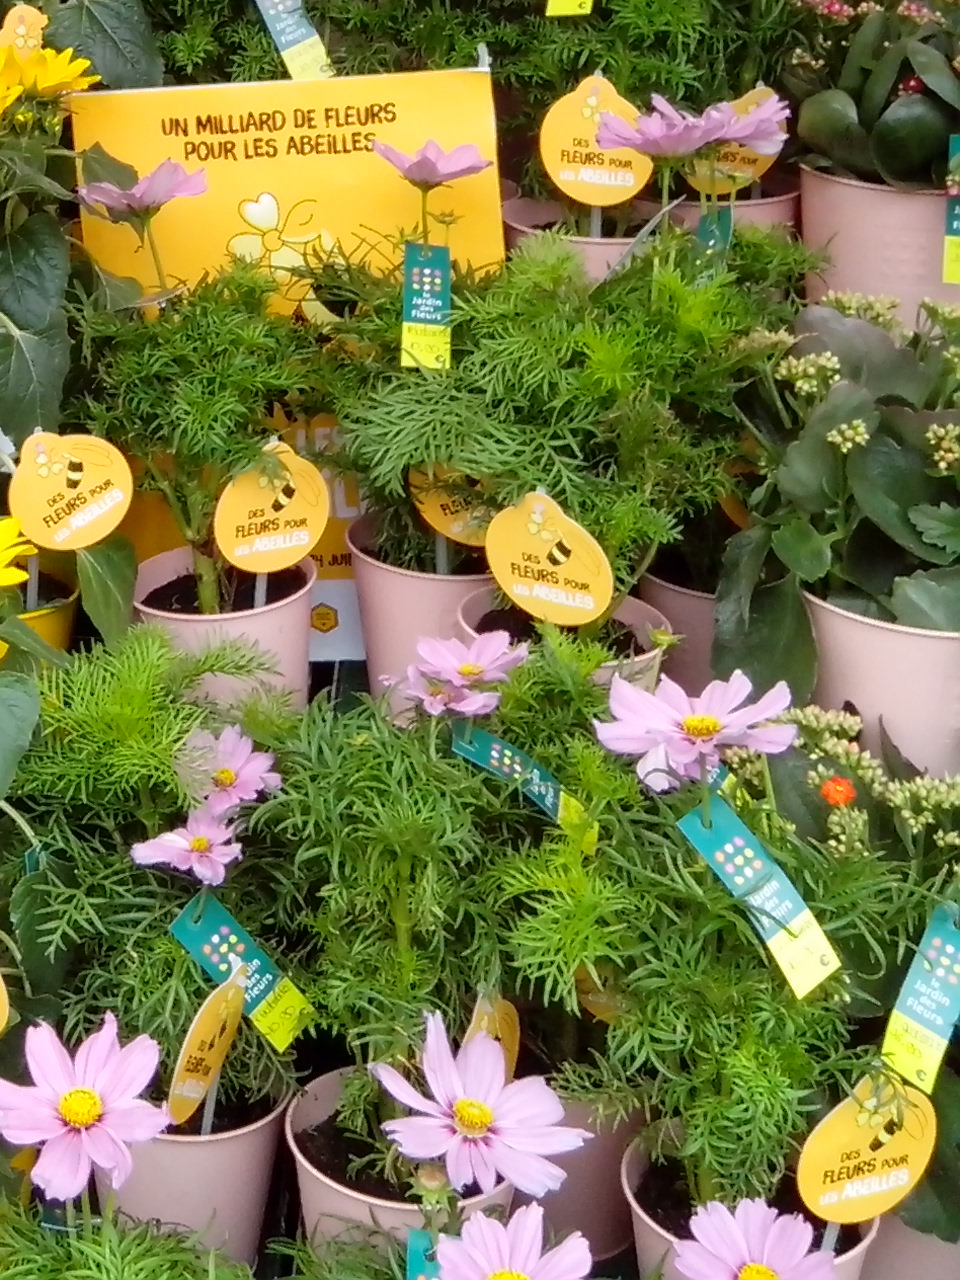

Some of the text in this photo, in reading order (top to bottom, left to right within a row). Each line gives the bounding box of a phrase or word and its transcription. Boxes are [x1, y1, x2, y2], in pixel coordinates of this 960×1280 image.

[162, 102, 398, 137] UN MILLIARD DE FLEURS
[184, 139, 236, 161] POUR
[245, 137, 279, 159] LES
[572, 138, 590, 150] DES
[560, 150, 634, 171] FLEURS POUR
[43, 478, 115, 528] FLEURS POUR
[47, 491, 66, 508] DES
[248, 508, 266, 520] DES
[235, 517, 309, 539] FLEURS POUR
[521, 551, 541, 565] DES
[510, 562, 591, 592] FLEURS POUR
[244, 972, 274, 1004] Fleurs
[840, 1149, 862, 1164] DES
[822, 1154, 910, 1186] FLEURS POUR
